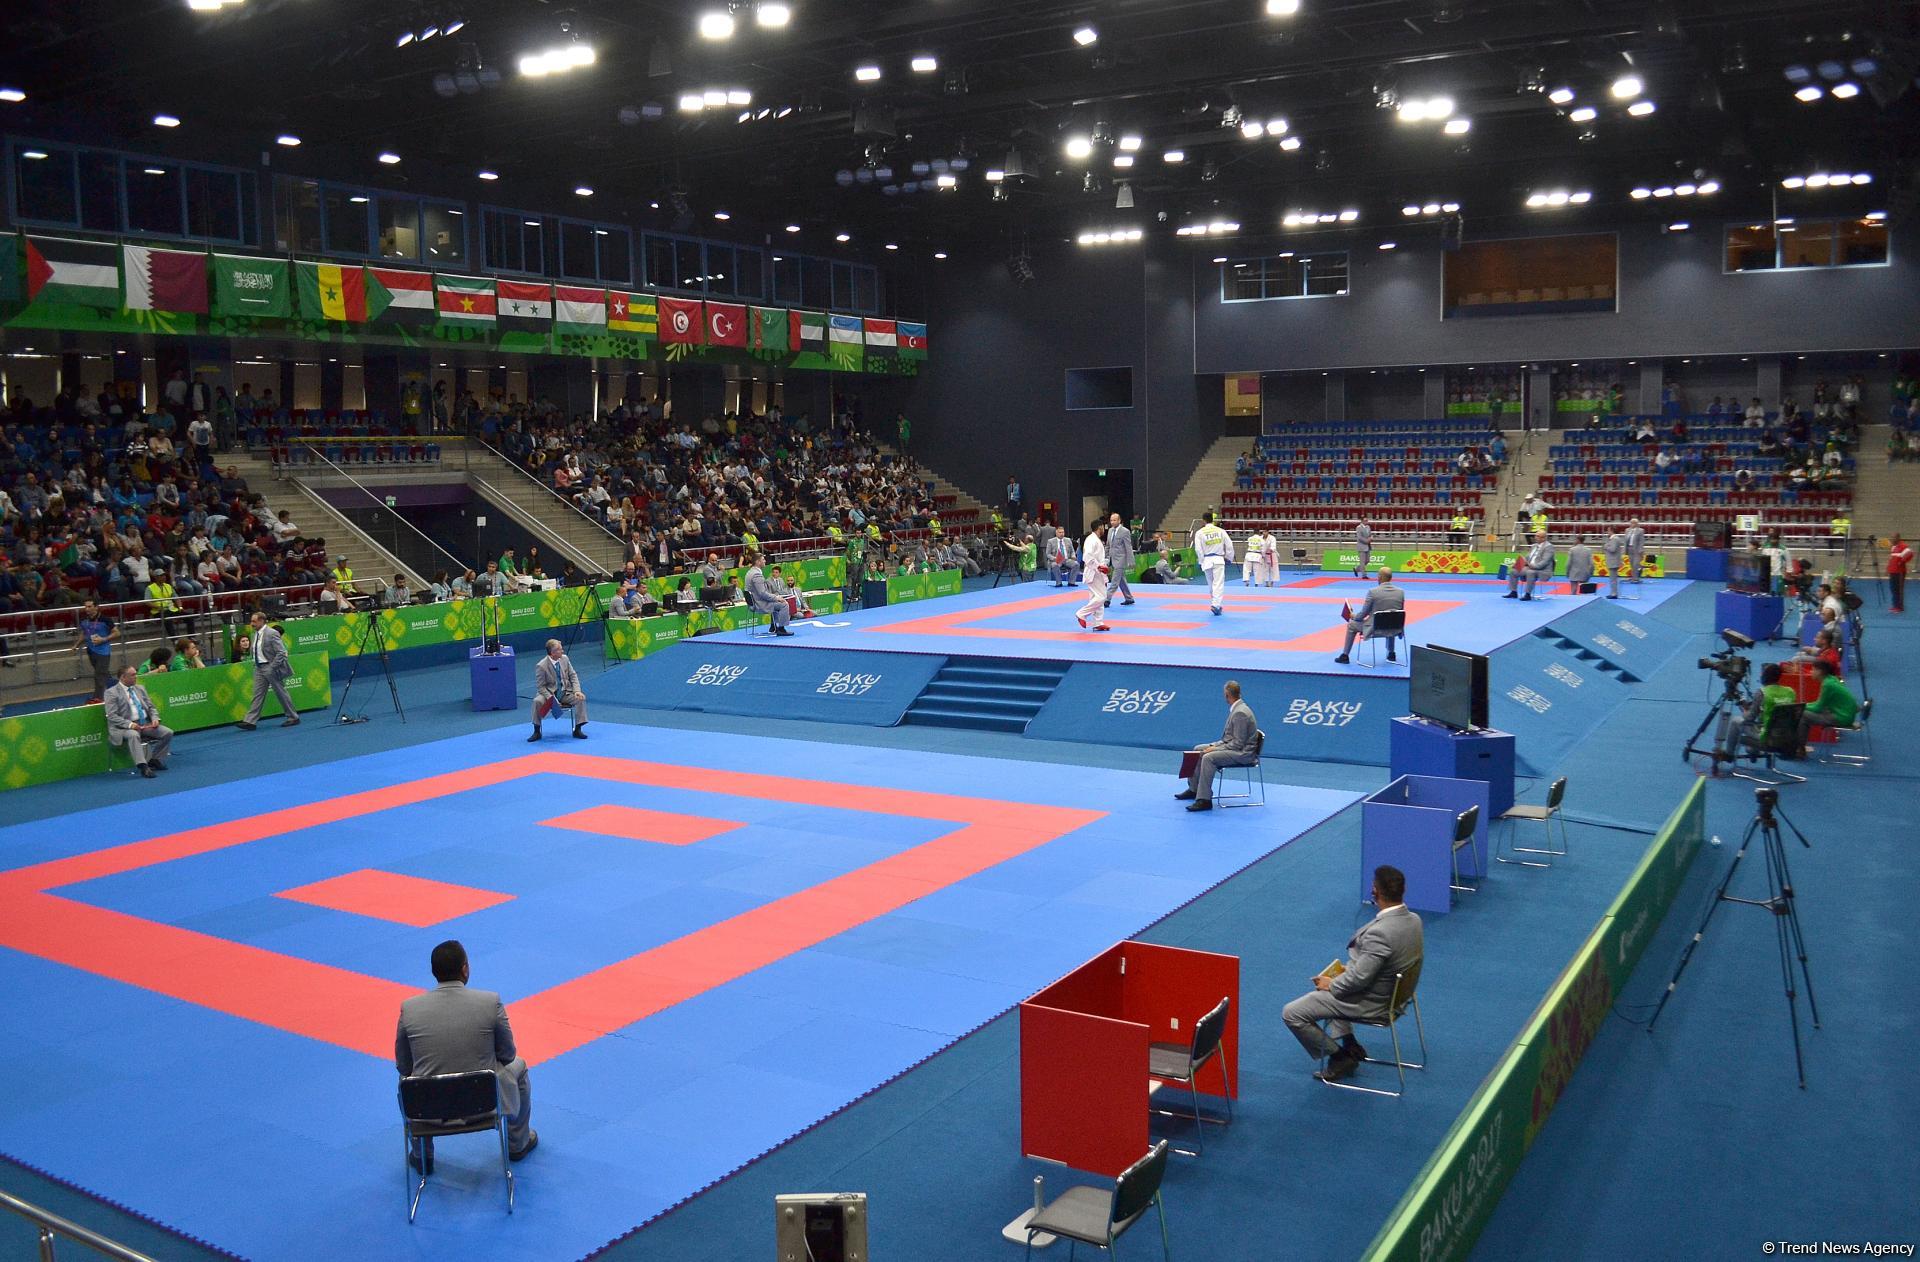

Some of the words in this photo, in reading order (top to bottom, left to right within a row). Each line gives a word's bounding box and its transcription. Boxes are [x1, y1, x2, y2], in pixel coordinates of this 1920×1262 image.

[695, 663, 748, 676] BAKU
[686, 674, 737, 686] 2017
[825, 671, 882, 685] BAKU
[816, 682, 872, 696] 2017
[1109, 688, 1176, 702] BAKU
[168, 694, 188, 703] BAKU
[189, 691, 208, 700] 2017
[1102, 700, 1169, 714] 2017
[1289, 699, 1362, 714] BAKU
[1283, 711, 1356, 726] 2017
[55, 736, 79, 747] BAKU
[80, 732, 102, 743] 2017
